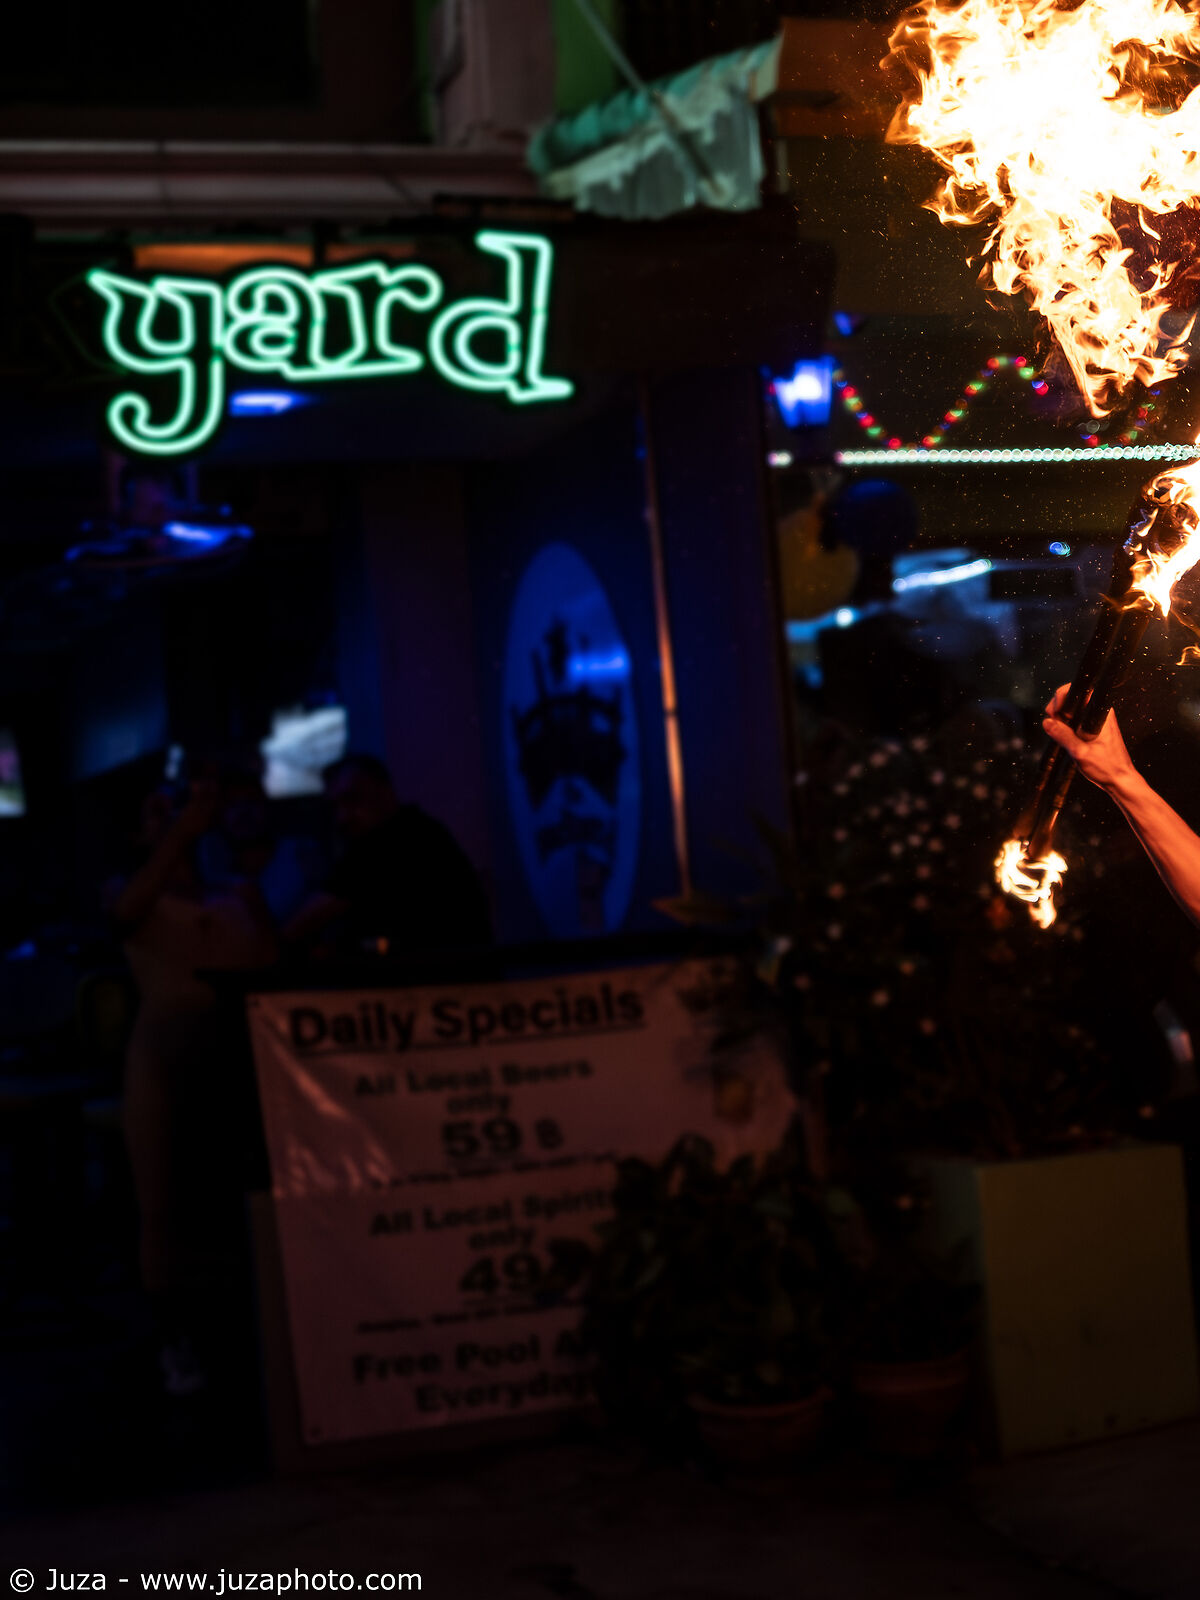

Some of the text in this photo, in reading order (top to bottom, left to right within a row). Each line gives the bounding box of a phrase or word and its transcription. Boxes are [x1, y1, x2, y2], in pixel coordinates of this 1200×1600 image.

[87, 229, 573, 455] yard
[288, 984, 644, 1051] Daily Specials
[356, 1056, 592, 1098] All Local Beers
[443, 1119, 521, 1159] 59
[371, 1211, 413, 1236] All
[423, 1202, 512, 1233] Local
[354, 1352, 440, 1385] Free
[456, 1341, 540, 1371] Pool
